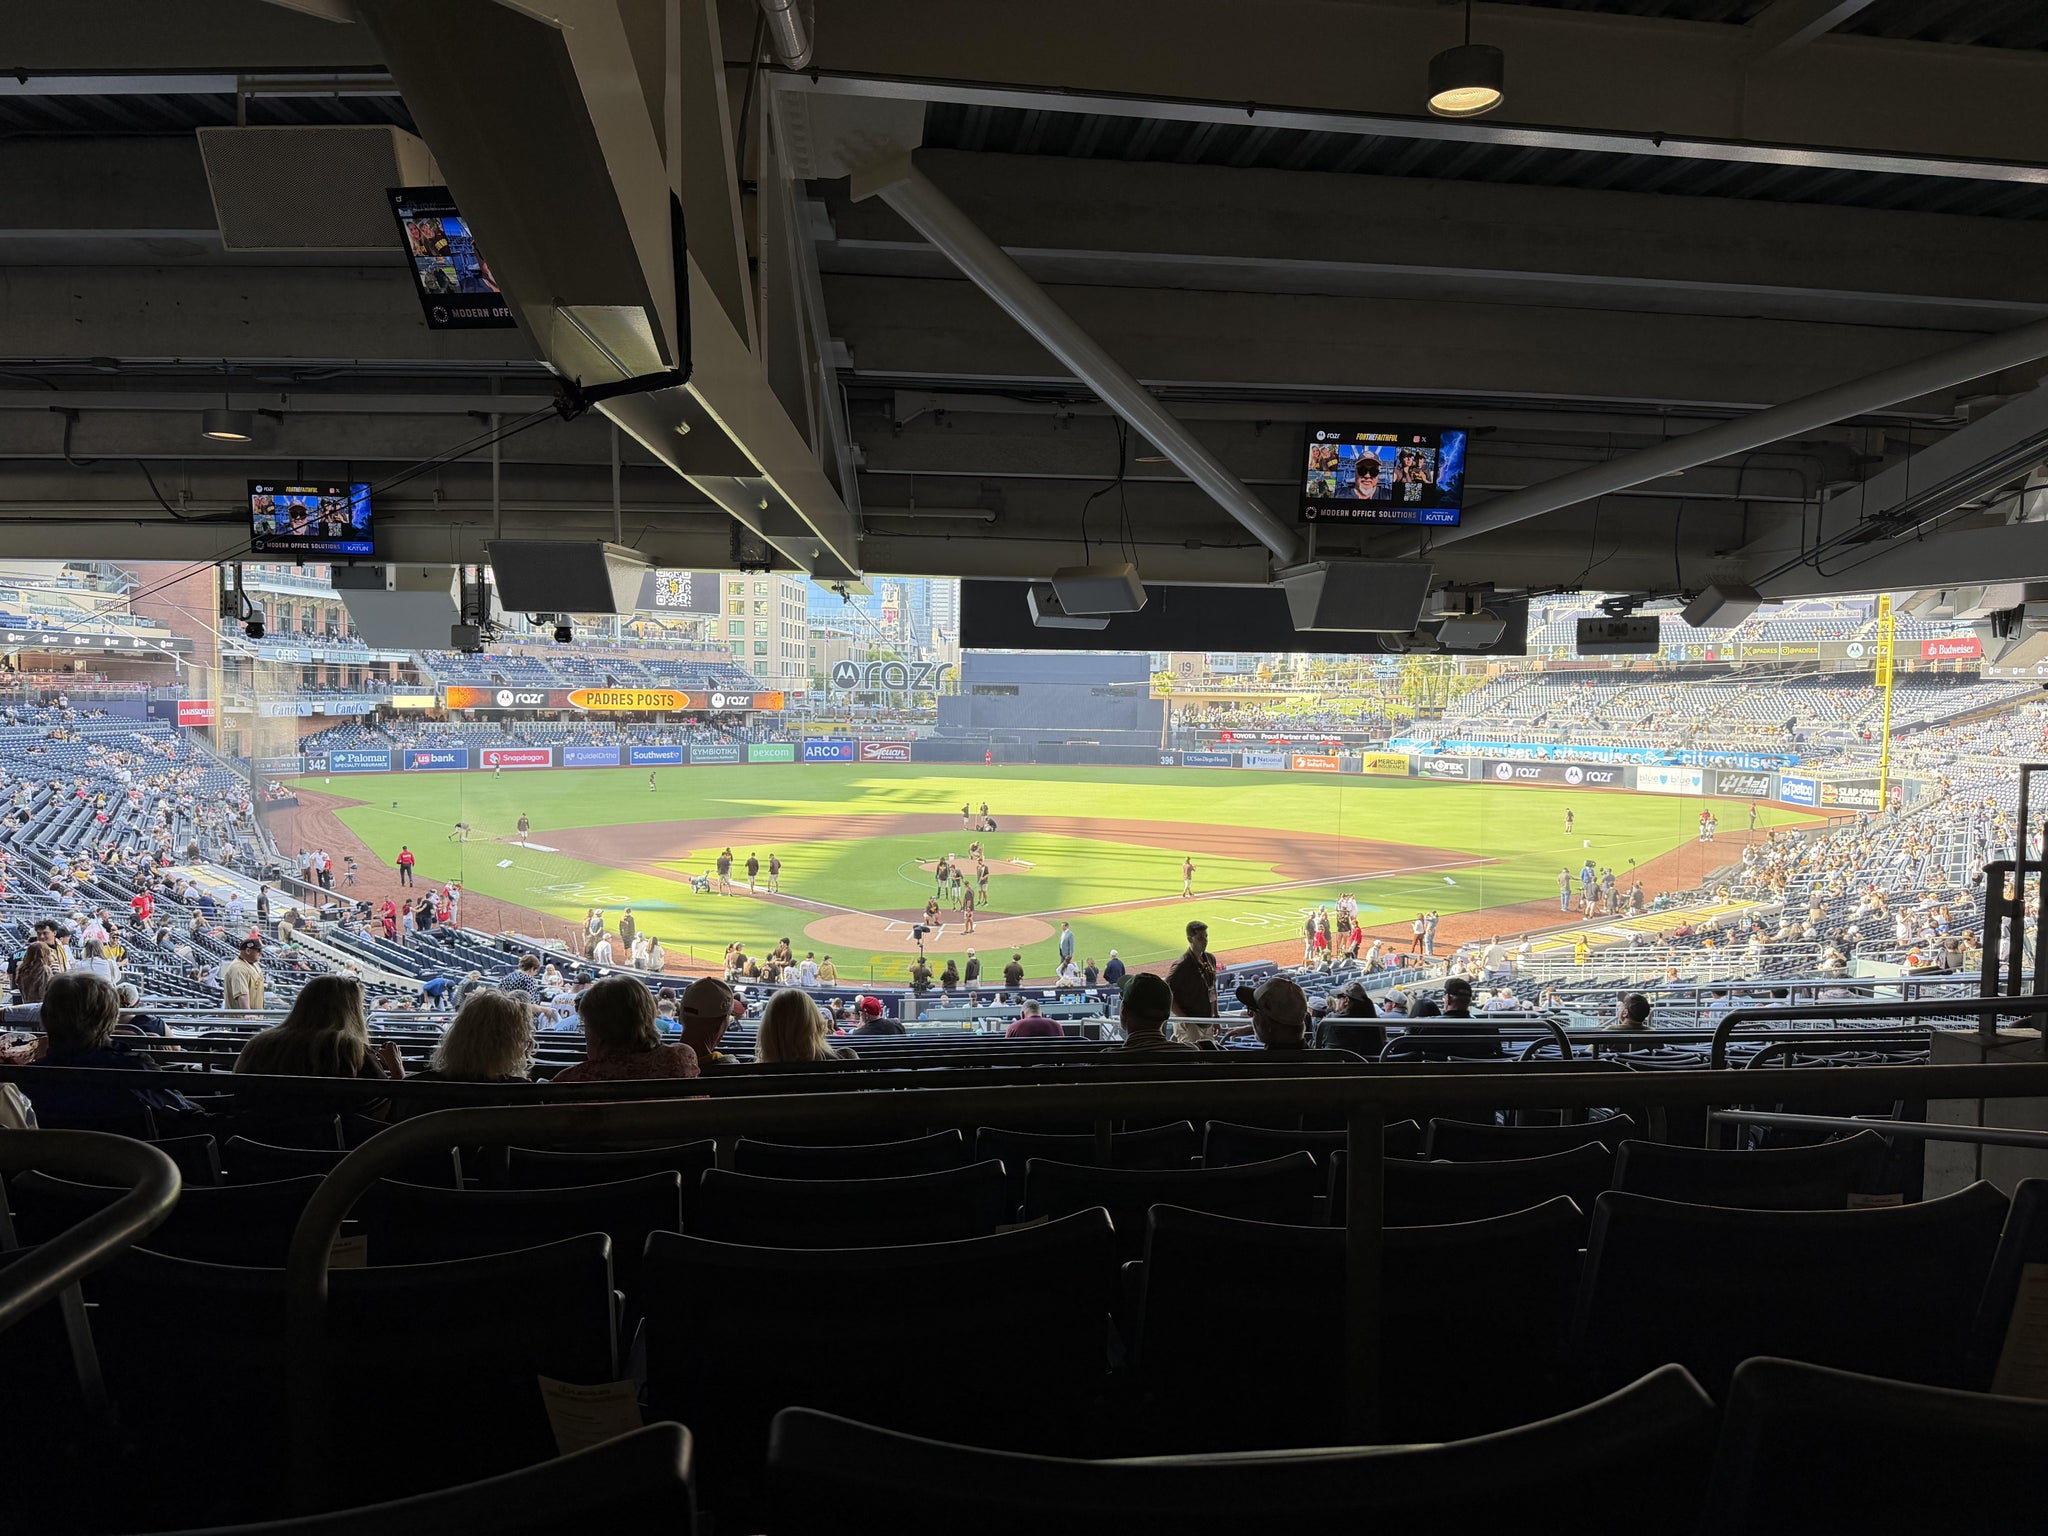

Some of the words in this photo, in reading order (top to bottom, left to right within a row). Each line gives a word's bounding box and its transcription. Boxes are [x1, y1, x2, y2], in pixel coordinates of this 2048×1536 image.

[451, 308, 490, 318] MODERN
[1320, 508, 1350, 517] MODERN
[1352, 509, 1376, 518] OFFICE
[1378, 510, 1417, 519] SOLUTIONS
[1425, 513, 1454, 522] KATUN
[275, 648, 299, 660] ORIS
[1939, 643, 1975, 655] Budweiser
[864, 660, 954, 691] razr
[514, 691, 545, 705] razr
[586, 691, 634, 706] PADRES
[637, 692, 675, 707] POSTS
[726, 694, 750, 706] razr
[1232, 732, 1257, 740] TOYOTA
[576, 752, 617, 761] QuidelOrtho
[633, 751, 675, 760] Southwest
[805, 746, 840, 757] ARCO
[347, 753, 388, 763] Palomar
[417, 754, 430, 763] us
[430, 753, 455, 763] bank
[502, 754, 545, 763] Snapdragon
[1160, 756, 1174, 766] 396
[308, 759, 327, 771] 342
[1515, 767, 1541, 778] razr
[1586, 771, 1613, 783] razr
[1639, 774, 1659, 784] blue
[1670, 776, 1691, 786] blue
[1791, 783, 1812, 798] petco
[1838, 787, 1859, 797] SLAP
